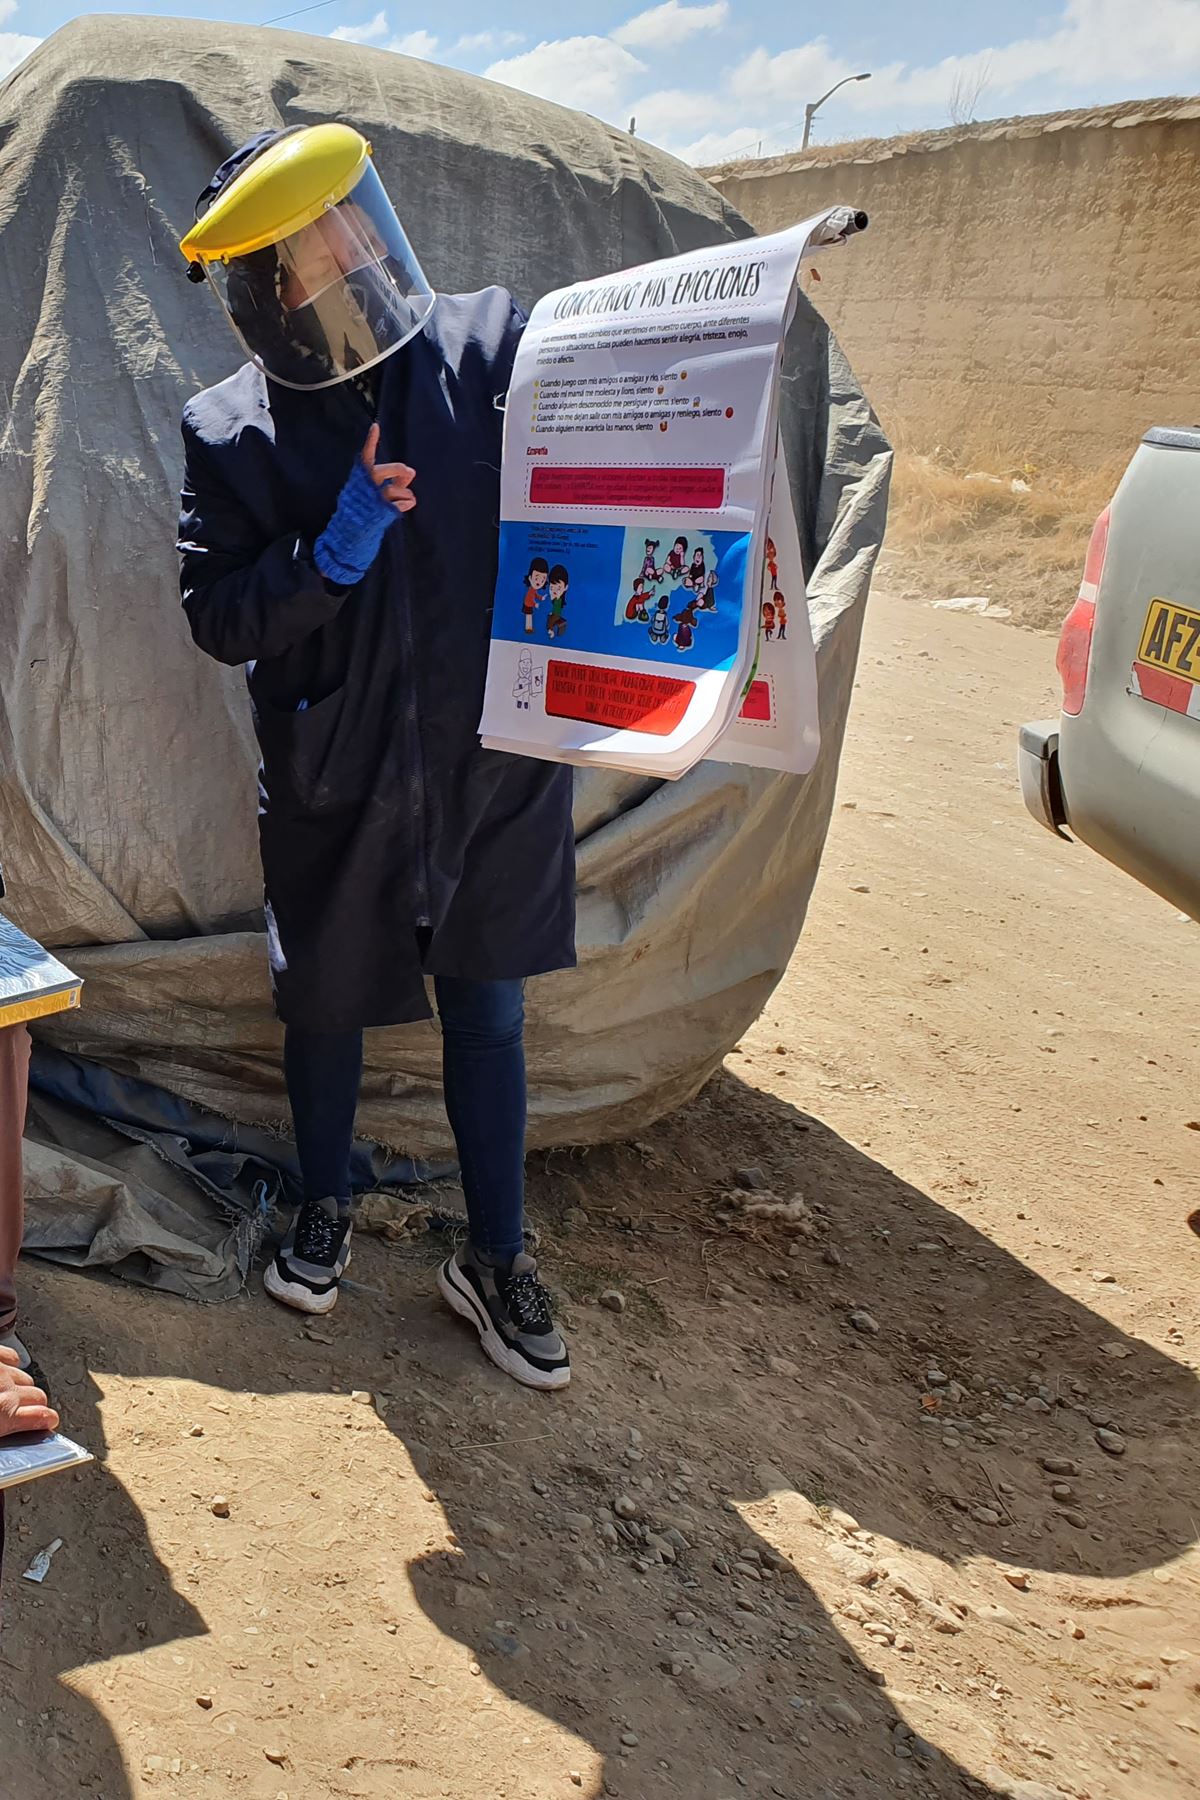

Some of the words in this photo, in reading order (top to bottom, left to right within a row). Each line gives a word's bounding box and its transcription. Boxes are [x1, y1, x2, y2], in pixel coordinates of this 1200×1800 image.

[554, 281, 642, 320] CONOCIENDO
[640, 276, 673, 309] MIS
[671, 262, 766, 305] EMOCIONES
[588, 330, 610, 338] cambios
[623, 326, 648, 334] sentimos
[657, 324, 679, 332] nuestro
[703, 319, 718, 328] ante
[718, 316, 750, 326] diferentes
[538, 346, 560, 354] personas
[612, 338, 633, 349] pueden
[661, 334, 678, 344] sentir
[728, 328, 748, 339] enojo,
[536, 357, 552, 365] miedo
[540, 379, 561, 388] Cuando
[561, 379, 577, 388] juego
[588, 377, 598, 385] mis
[598, 376, 618, 385] amigos
[624, 374, 644, 384] amigas
[539, 391, 559, 399] Cuando
[560, 390, 567, 398] mi
[595, 388, 616, 396] molesta
[636, 386, 654, 394] siento
[538, 402, 558, 410] Cuando
[558, 401, 578, 411] alguien
[579, 400, 612, 409] desconocido
[623, 398, 648, 408] persigue
[671, 397, 690, 405] siento
[537, 413, 556, 421] Cuando
[574, 413, 588, 421] dejan
[589, 412, 601, 420] salir
[623, 411, 644, 420] amigos
[650, 410, 671, 420] amigas
[702, 408, 722, 417] siento
[536, 424, 555, 432] Cuando
[555, 424, 574, 434] alguien
[585, 424, 605, 432] acaricia
[606, 423, 614, 431] las
[635, 423, 653, 431] siento
